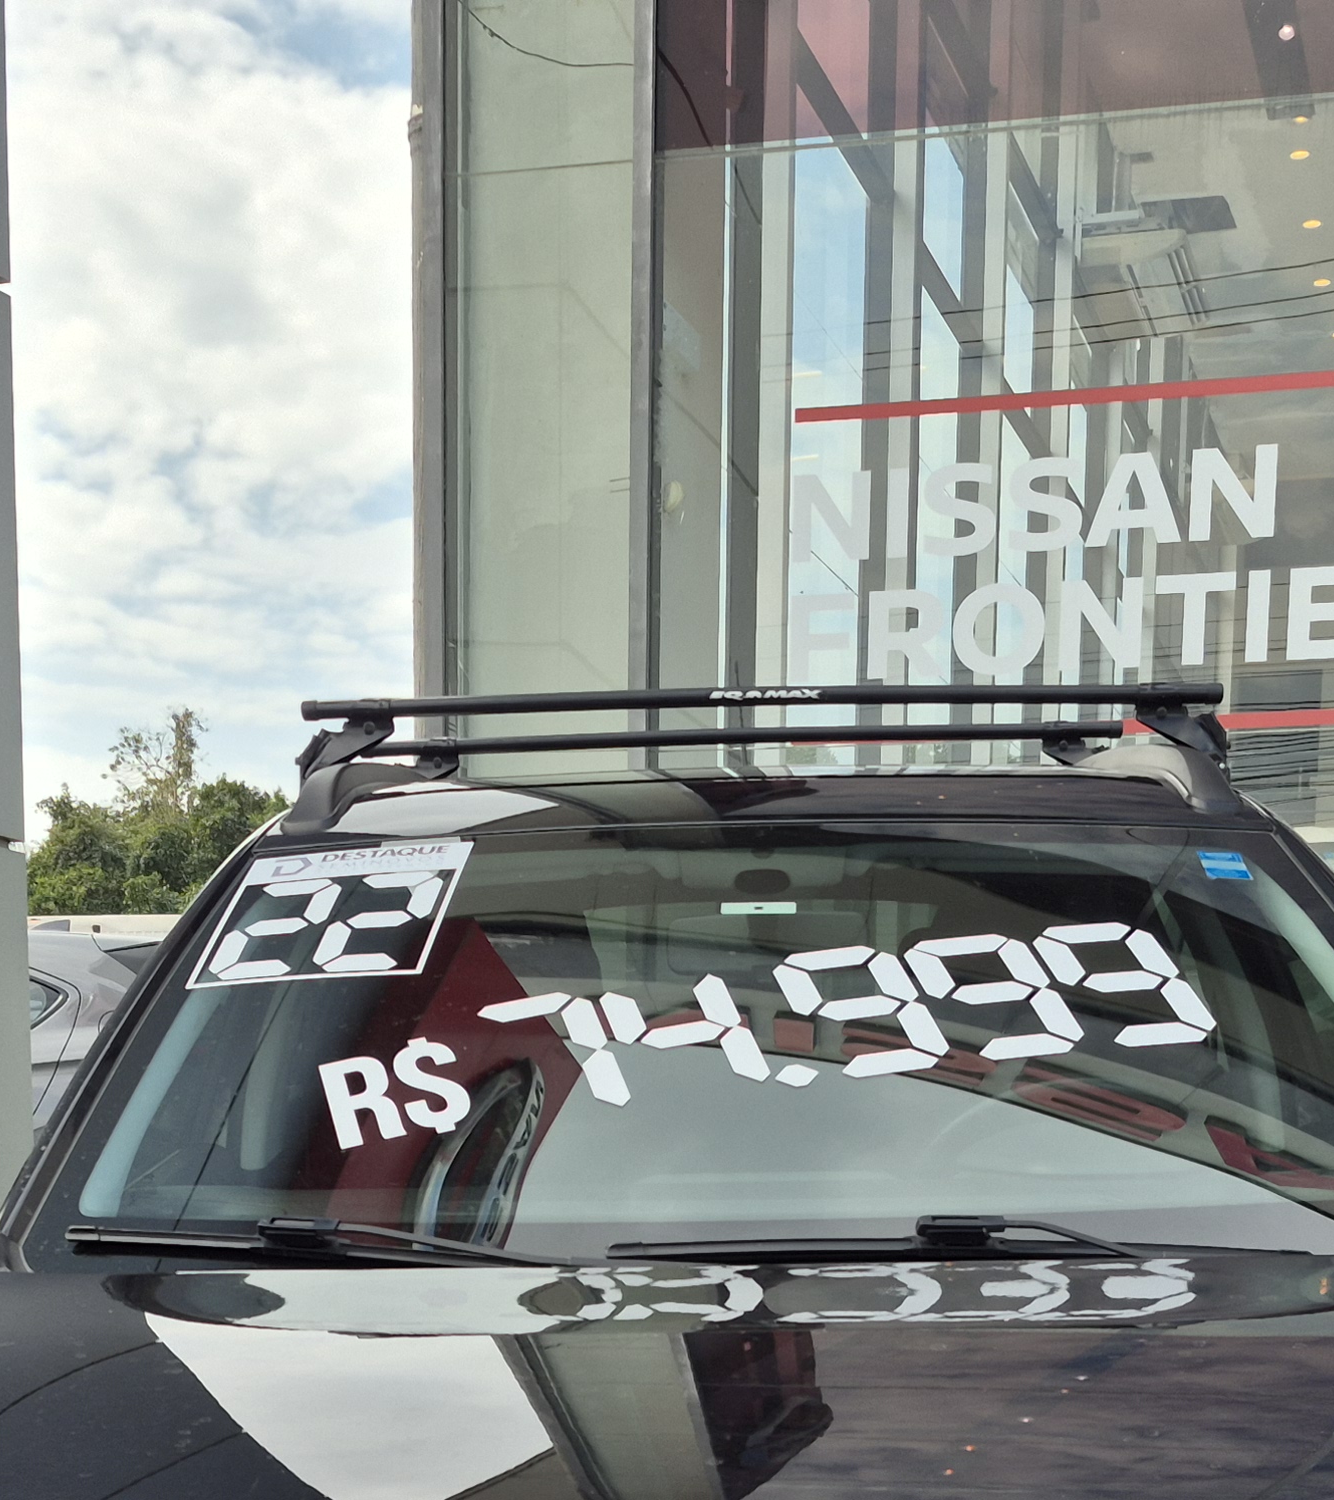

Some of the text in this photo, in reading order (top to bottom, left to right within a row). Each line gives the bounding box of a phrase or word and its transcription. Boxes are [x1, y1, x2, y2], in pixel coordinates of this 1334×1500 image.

[791, 443, 1279, 564] NISSAN
[320, 845, 451, 863] DESTAQUE
[208, 870, 444, 981] 22
[318, 921, 1217, 1151] R$ 74.999
